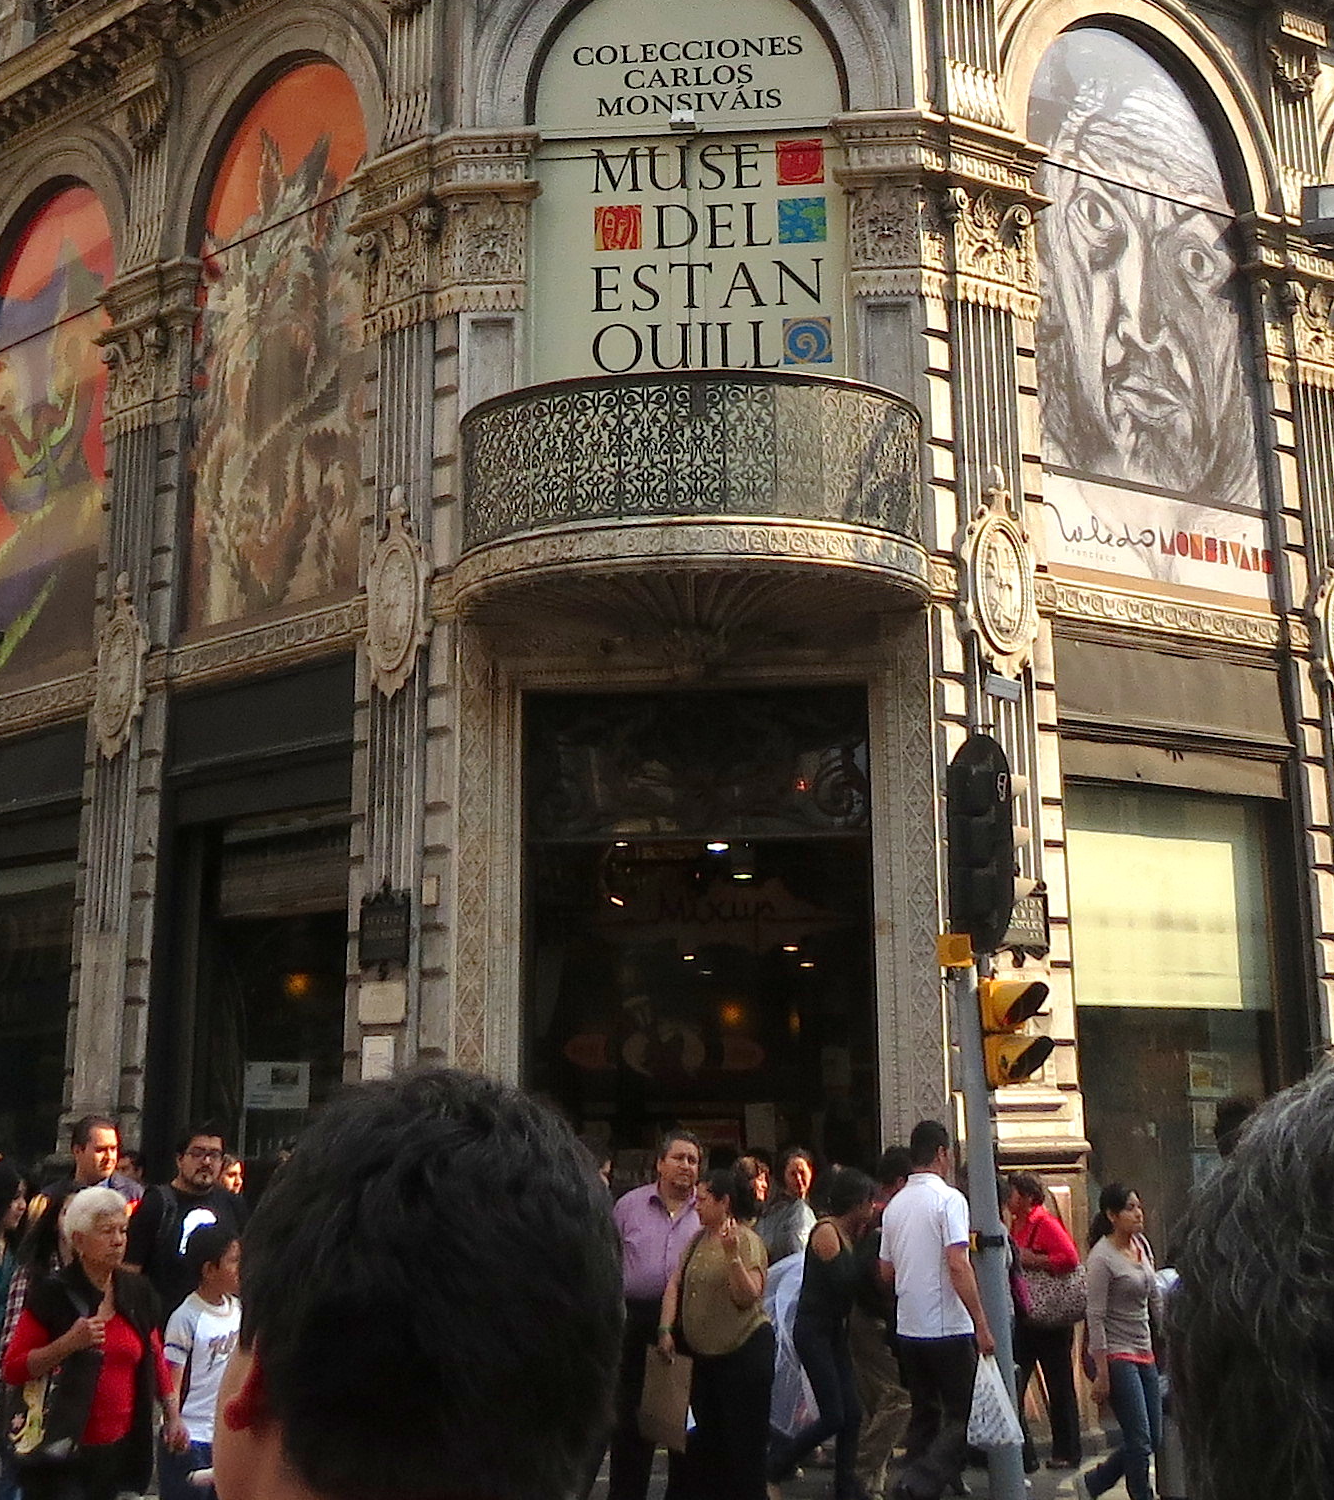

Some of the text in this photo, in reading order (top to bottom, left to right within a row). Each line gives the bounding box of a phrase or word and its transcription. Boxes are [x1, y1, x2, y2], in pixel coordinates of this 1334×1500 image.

[573, 36, 803, 67] COLECCIONES
[623, 63, 754, 90] CARLOS
[596, 84, 783, 117] MONSIVÁIS
[654, 202, 773, 251] DEL
[591, 258, 824, 313] ESTAN
